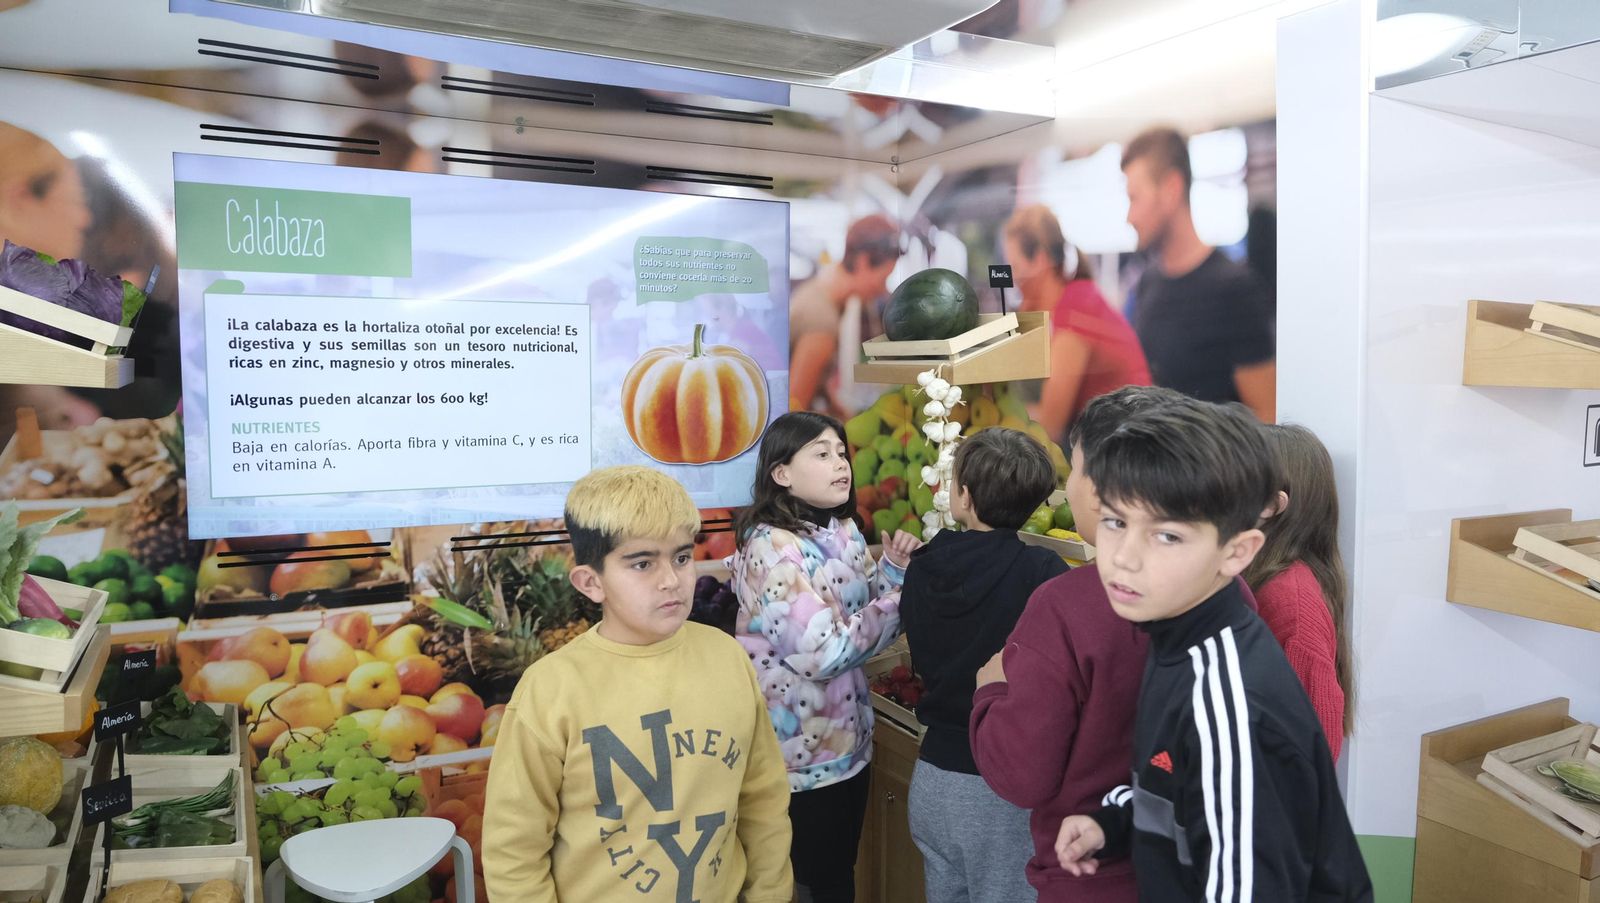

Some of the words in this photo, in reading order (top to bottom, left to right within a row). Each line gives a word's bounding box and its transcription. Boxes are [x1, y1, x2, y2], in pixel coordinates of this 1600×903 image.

[226, 198, 326, 258] Calabaza
[640, 244, 673, 256] ¿Sabías
[675, 248, 691, 257] que
[693, 250, 712, 259] para
[714, 250, 752, 261] preservar
[639, 258, 663, 268] todos
[683, 261, 724, 271] nutrientes
[726, 264, 737, 272] no
[640, 271, 677, 281] conviene
[680, 272, 708, 282] cocerla
[710, 273, 728, 284] más
[730, 274, 740, 284] de
[742, 276, 752, 284] 20
[640, 283, 678, 293] minutos?
[227, 318, 249, 331] ¡La
[255, 318, 318, 332] calabaza
[323, 322, 339, 332] es
[345, 320, 357, 332] la
[362, 320, 420, 334] hortaliza
[425, 322, 465, 335] otoñal
[470, 324, 491, 337] por
[495, 324, 560, 336] excelencia!
[565, 325, 578, 336] Es
[228, 336, 295, 352] digestiva
[302, 340, 312, 353] y
[319, 340, 344, 350] sus
[351, 338, 407, 351] semillas
[414, 342, 437, 351] son
[444, 342, 460, 352] un
[467, 340, 506, 352] tesoro
[512, 341, 578, 354] nutricional,
[229, 356, 263, 368] ricas
[269, 358, 286, 368] en
[292, 356, 324, 370] zinc,
[330, 357, 395, 372] magnesio
[400, 360, 408, 372] y
[413, 358, 446, 369] otros
[451, 357, 515, 370] minerales.
[230, 393, 294, 408] ¡Algunas
[300, 393, 351, 408] pueden
[356, 392, 412, 406] alcanzar
[416, 392, 436, 404] los
[440, 392, 464, 404] 600
[469, 392, 488, 406] kg!
[231, 420, 321, 435] NUTRIENTES
[232, 441, 264, 456] Baja
[270, 441, 288, 452] en
[294, 438, 352, 452] calorías.
[357, 438, 402, 452] Aporta
[408, 436, 437, 449] fibra
[442, 438, 449, 450] y
[454, 434, 507, 448] vitamina
[512, 434, 524, 446] C,
[528, 436, 536, 447] y
[540, 434, 554, 445] es
[558, 432, 579, 445] rica
[232, 462, 250, 472] en
[256, 458, 318, 472] vitamina
[322, 457, 336, 470] A.
[123, 658, 150, 670] Almería
[101, 711, 136, 730] Almería
[672, 729, 741, 770] NEW
[582, 708, 674, 820] N
[600, 824, 661, 894] CITY
[646, 810, 726, 903] Y
